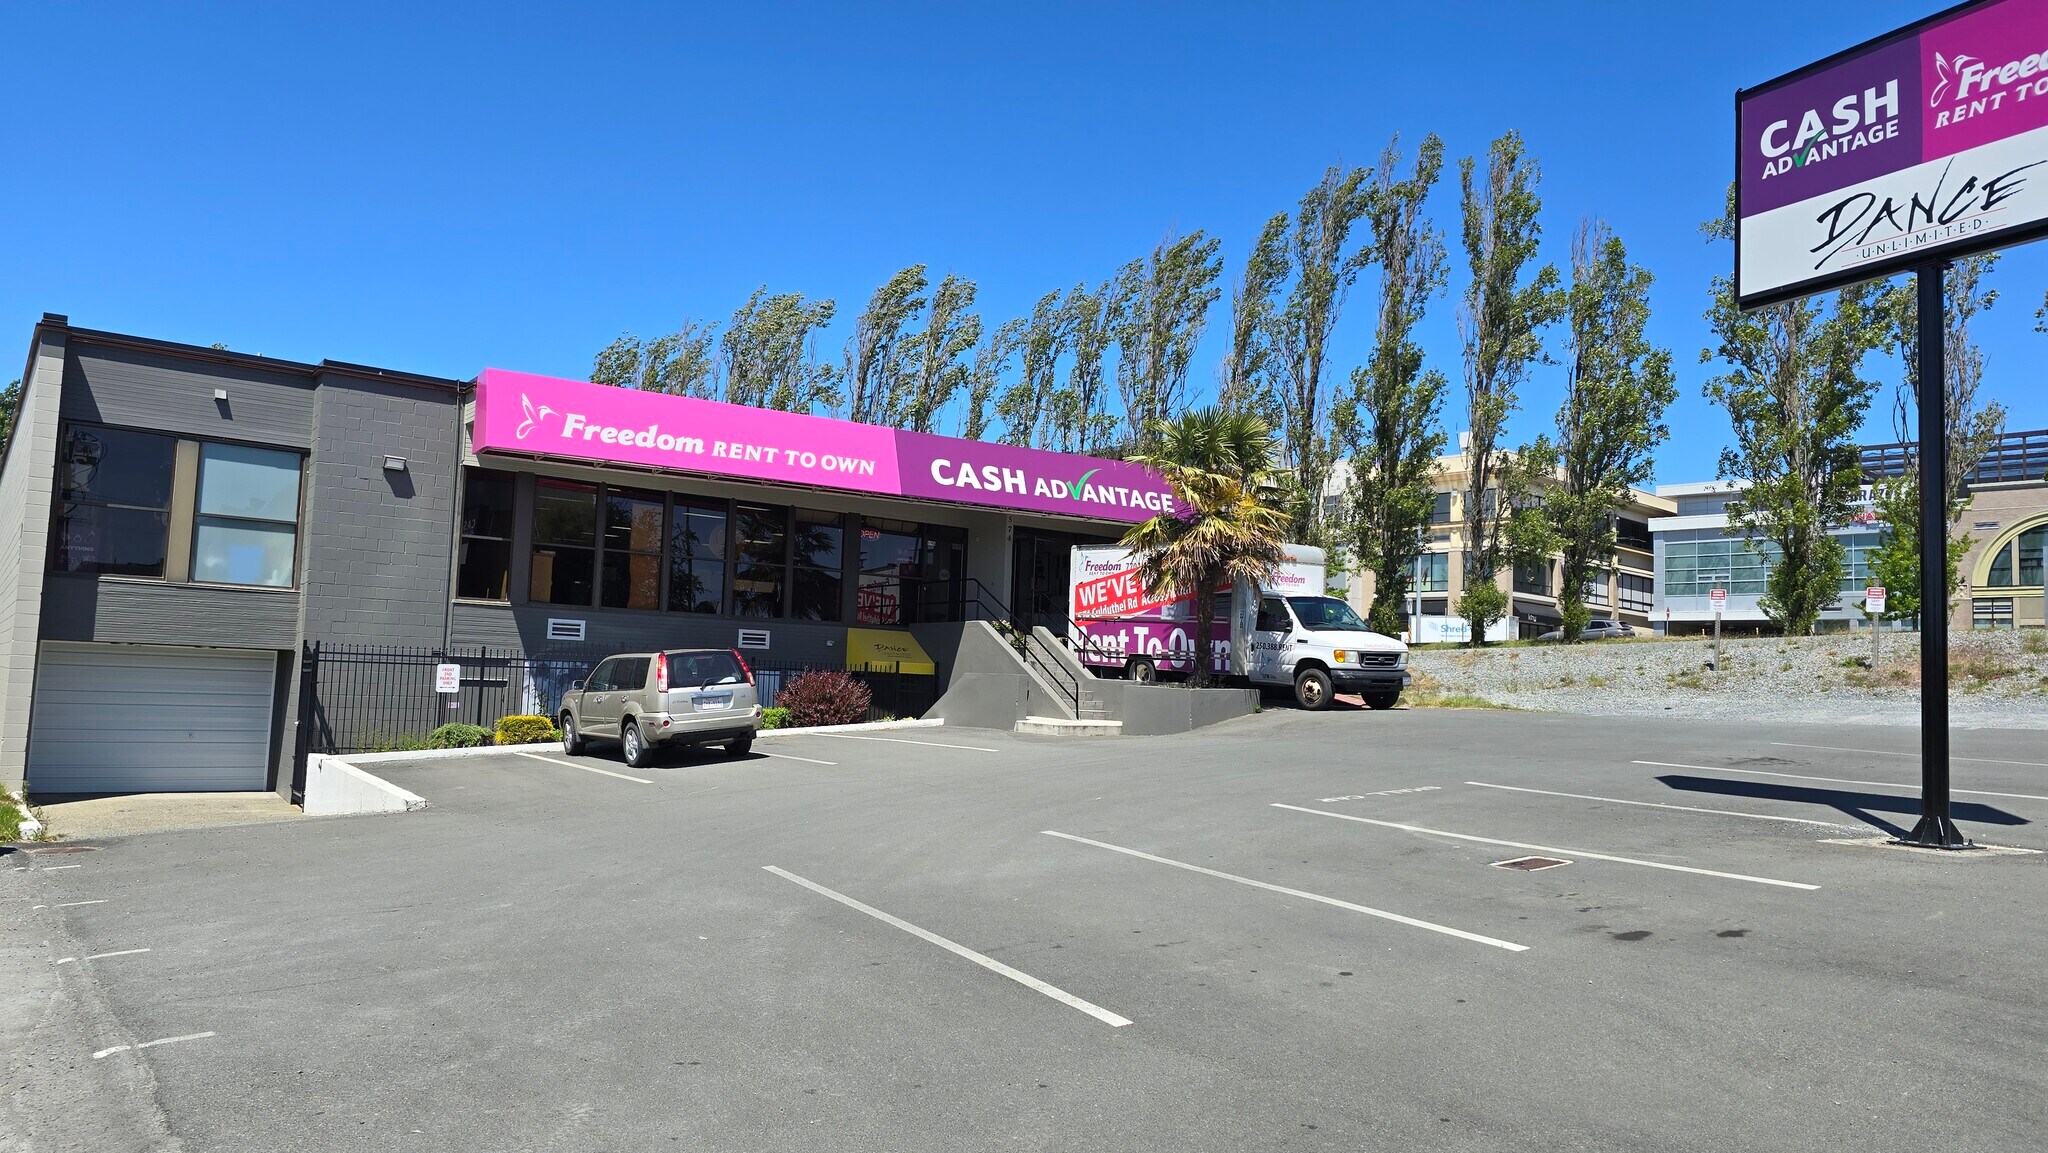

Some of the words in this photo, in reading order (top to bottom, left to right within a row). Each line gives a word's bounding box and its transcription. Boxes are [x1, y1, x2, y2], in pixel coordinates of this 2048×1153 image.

[1760, 78, 1899, 158] CASH
[1934, 91, 2007, 129] RENT
[1761, 118, 1899, 180] ADVANTAGE
[1810, 156, 2048, 270] DANCE
[560, 413, 705, 455] Freedom
[711, 441, 780, 465] RENT
[784, 449, 817, 469] TO
[820, 454, 876, 477] OWN
[930, 458, 1028, 495] CASH
[1034, 468, 1175, 513] ADVANTAGE
[1085, 560, 1122, 572] Freedom
[1079, 575, 1138, 608] WE'VE
[1091, 601, 1127, 619] Culduthel
[1127, 596, 1139, 609] Rd
[1073, 624, 1130, 666] Rent
[1133, 626, 1163, 667] To
